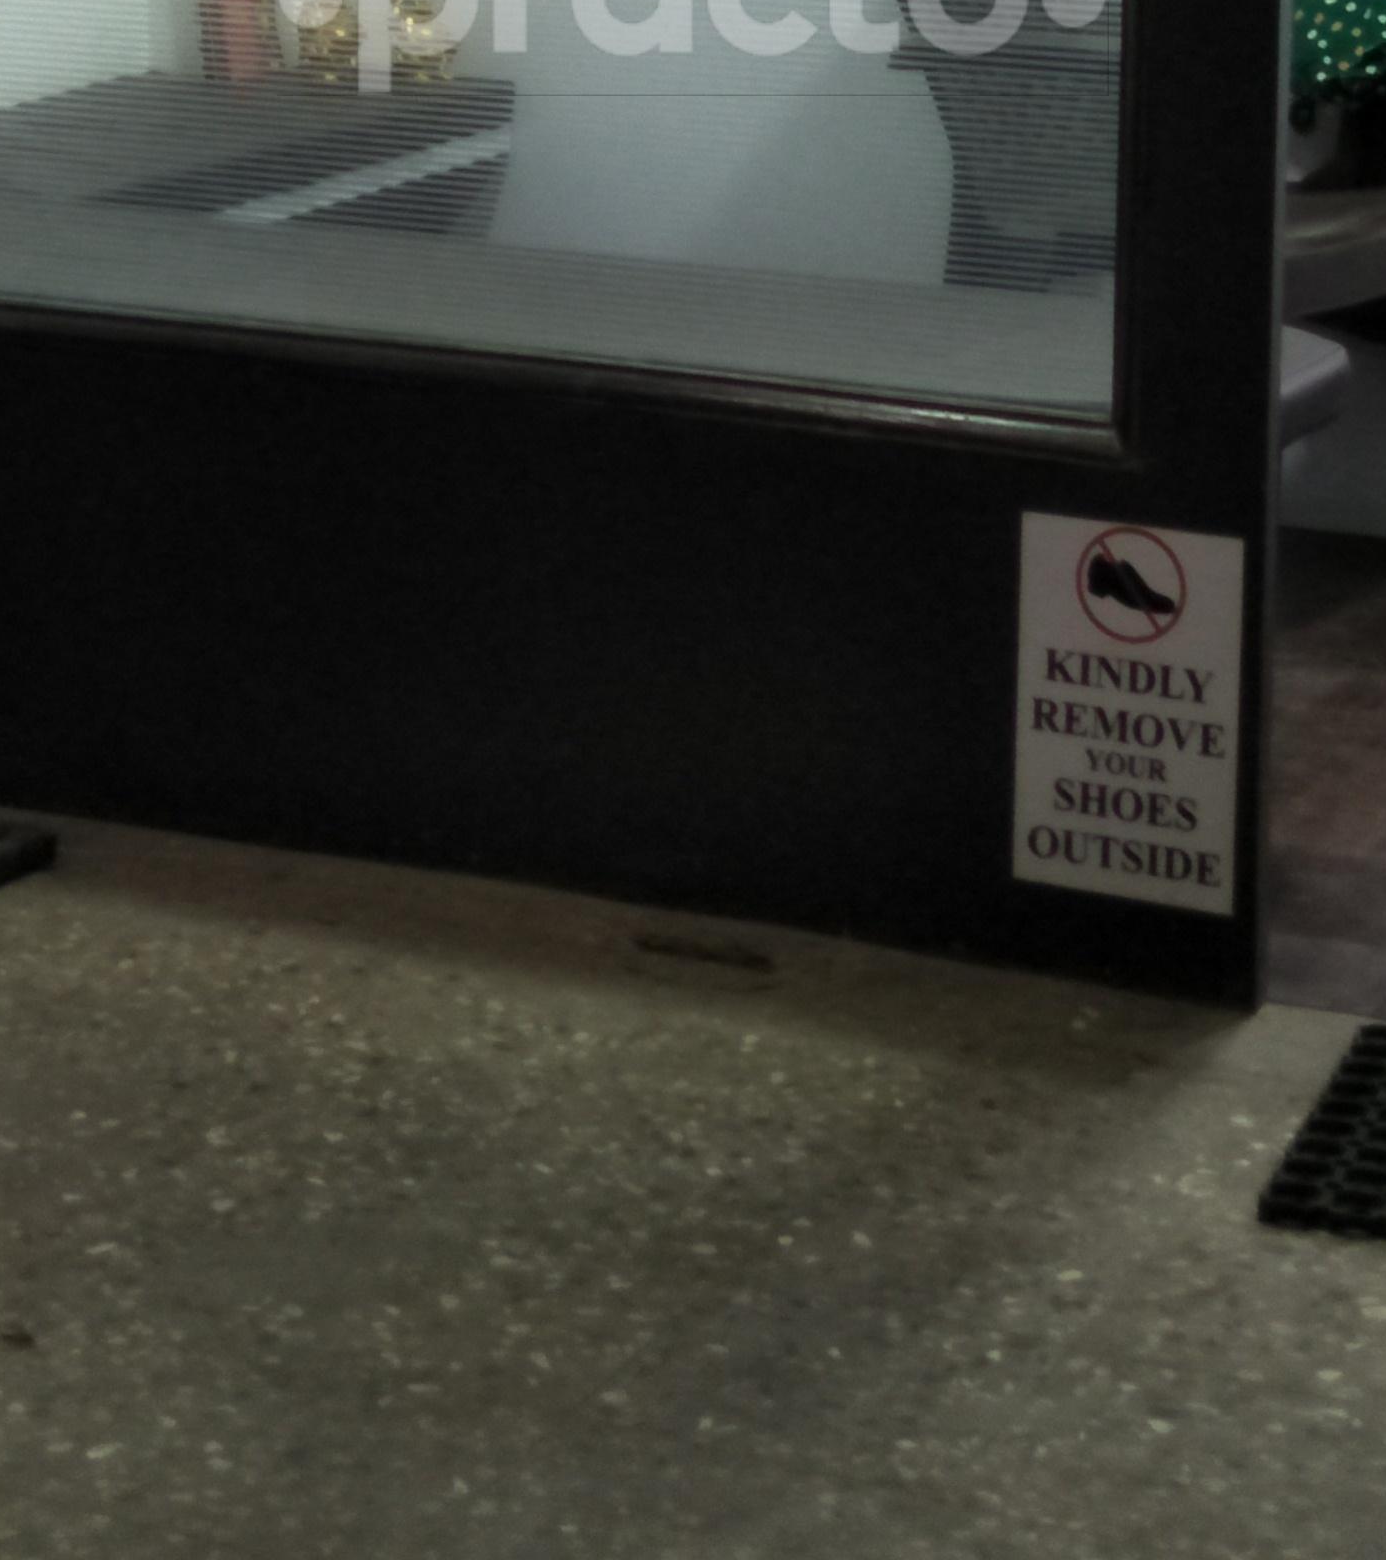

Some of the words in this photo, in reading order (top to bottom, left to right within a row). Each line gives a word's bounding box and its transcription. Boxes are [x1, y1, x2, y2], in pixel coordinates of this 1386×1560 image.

[1045, 648, 1214, 704] KINDLY
[1031, 697, 1226, 760] REMOVE
[1085, 748, 1167, 783] YOUR
[1053, 777, 1198, 832] SHOES
[1027, 824, 1222, 889] OUTSIDE
